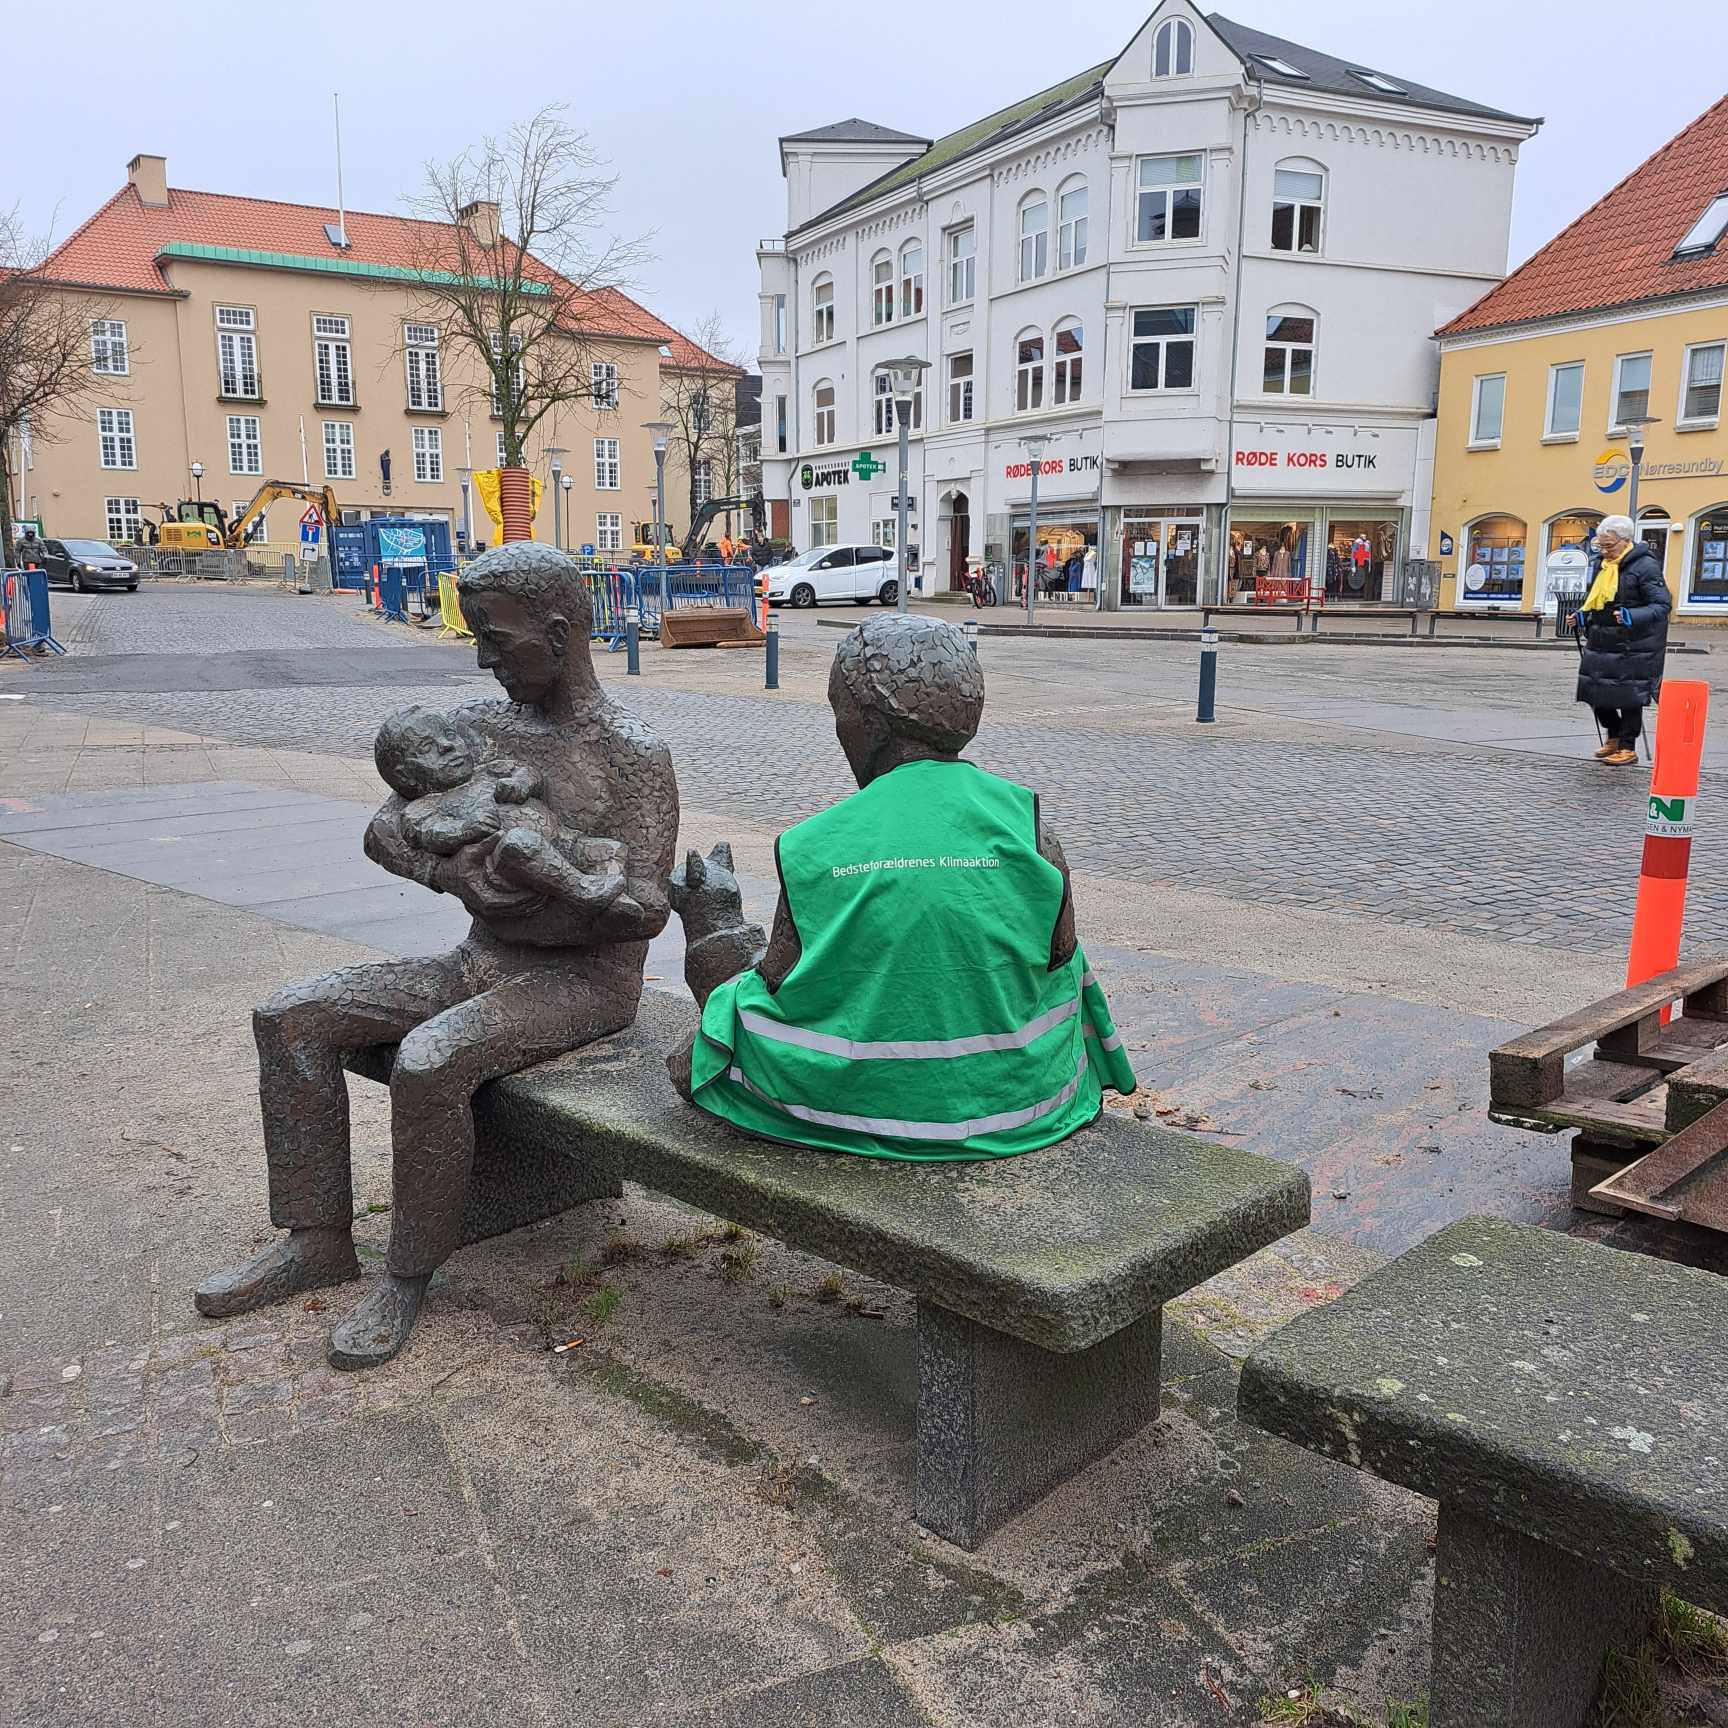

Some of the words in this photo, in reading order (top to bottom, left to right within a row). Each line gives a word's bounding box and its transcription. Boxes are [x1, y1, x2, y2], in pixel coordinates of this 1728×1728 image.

[1006, 463, 1032, 479] RØDE
[1038, 460, 1064, 475] KORS
[1069, 455, 1100, 472] BUTIK
[1235, 451, 1278, 467] RØDE
[1287, 452, 1328, 468] KORS
[1335, 453, 1377, 469] BUTIK
[814, 469, 850, 488] APOTEK
[1592, 463, 1630, 478] EDC
[832, 856, 936, 878] Bedsteforældrenes
[939, 855, 1000, 868] Klimaaktion
